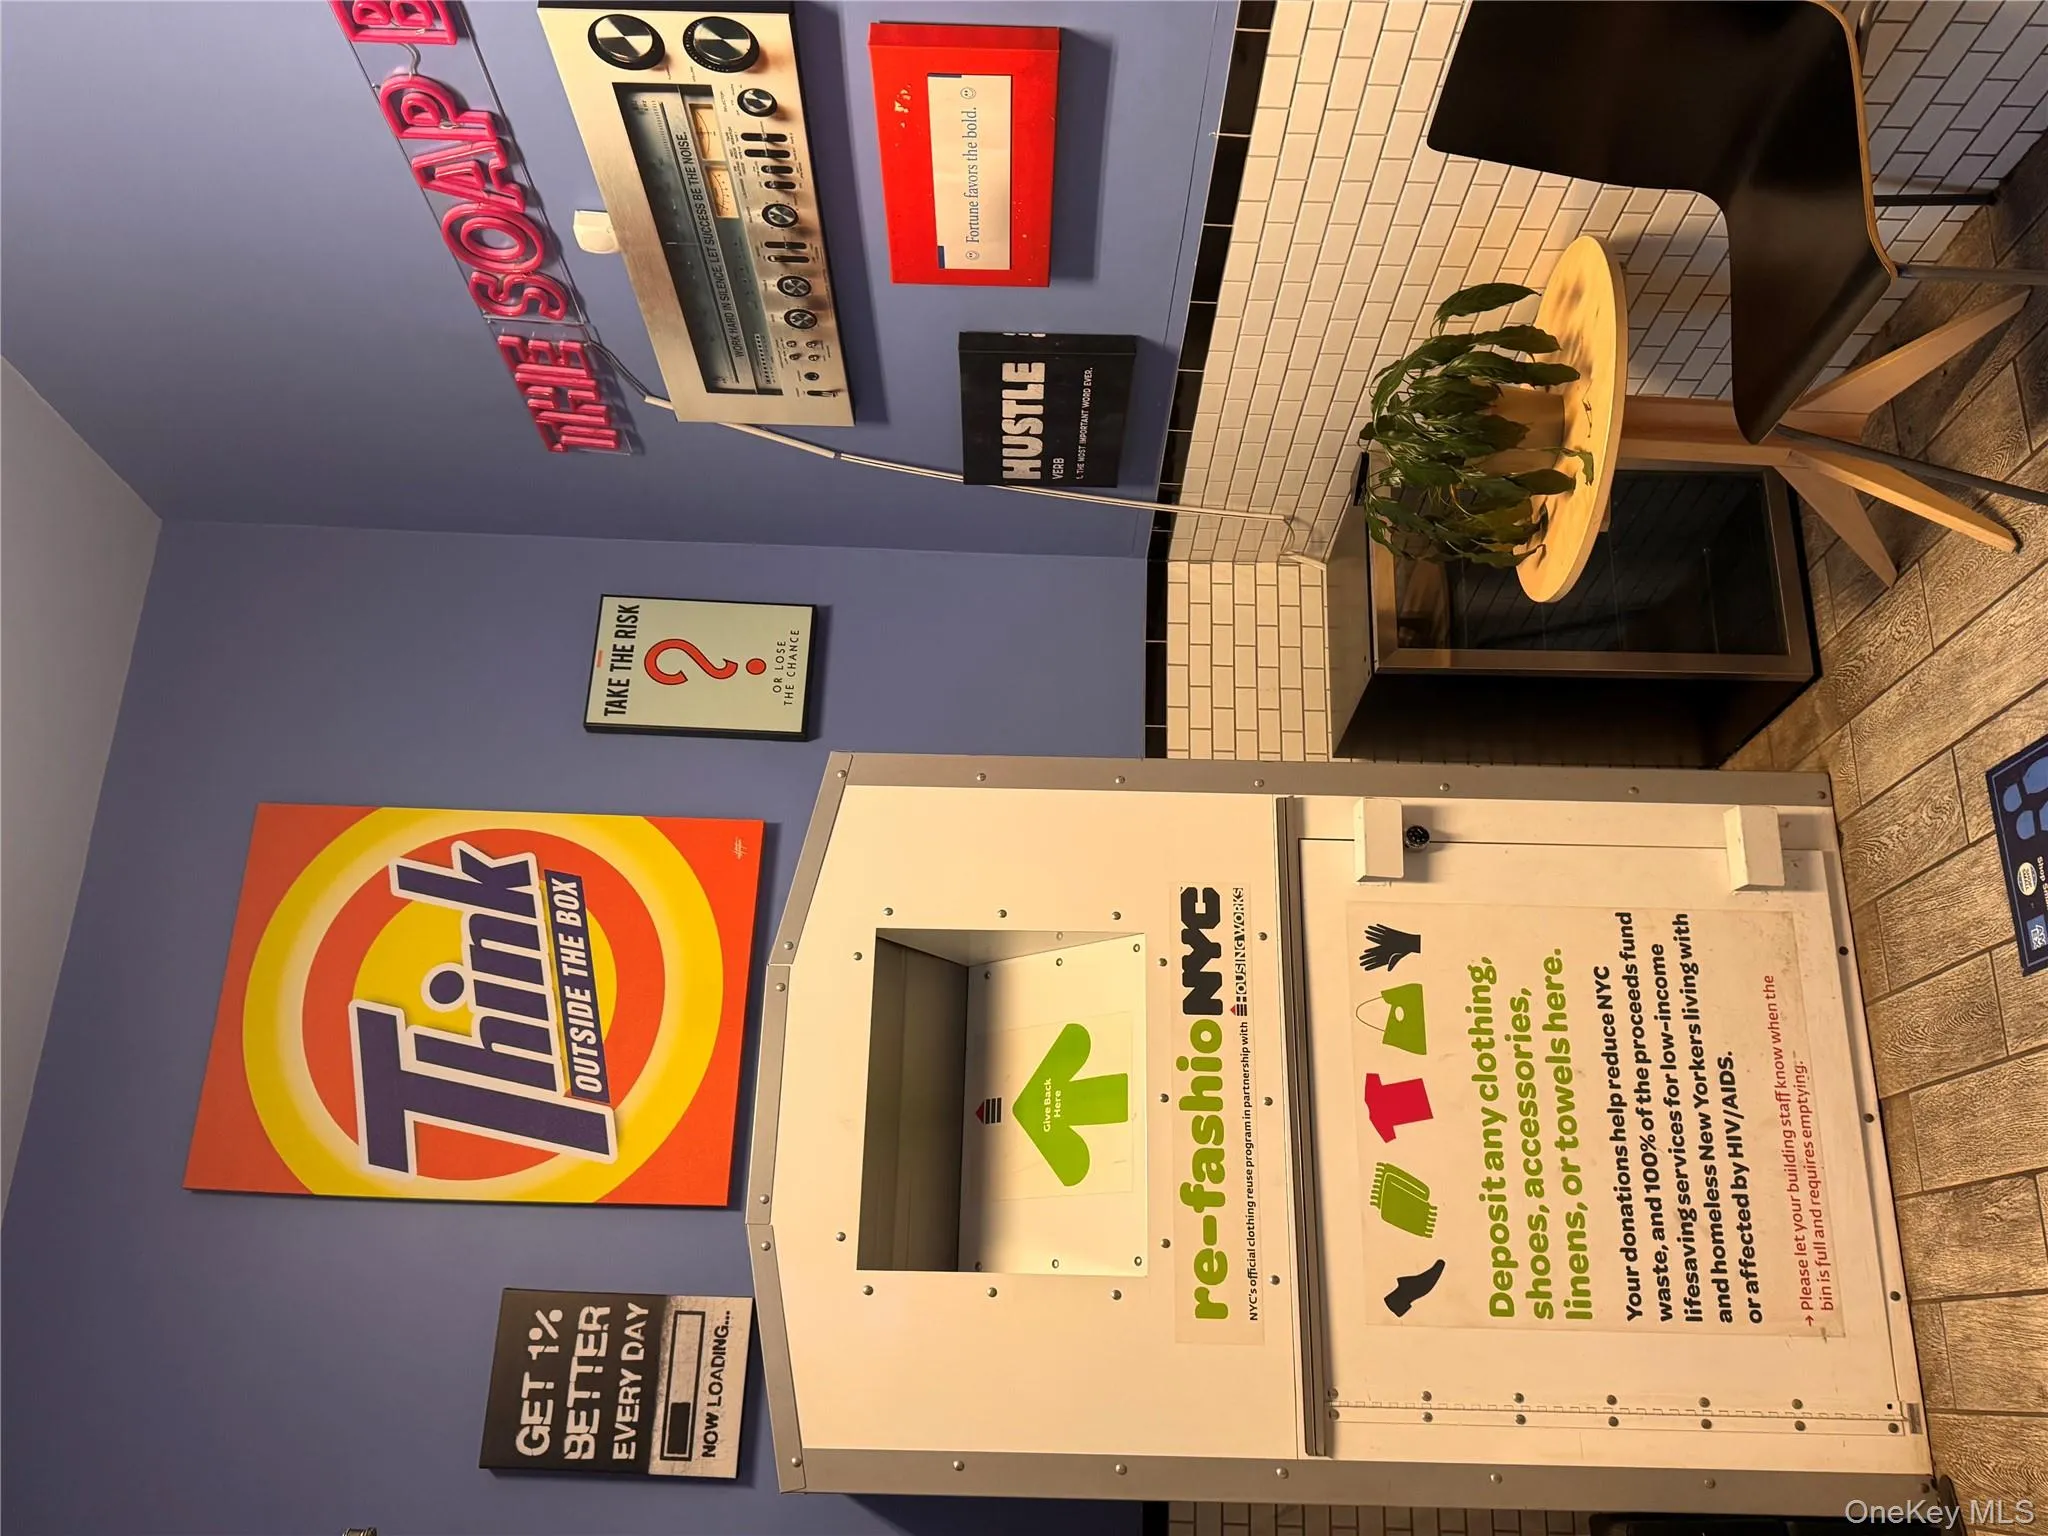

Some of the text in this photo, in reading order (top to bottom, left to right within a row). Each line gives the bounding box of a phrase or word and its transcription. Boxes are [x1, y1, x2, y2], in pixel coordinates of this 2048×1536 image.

[676, 131, 695, 165] NOISE.
[684, 167, 699, 186] THE
[961, 107, 979, 243] Fortune favors the bold.
[378, 73, 568, 322] SOAP
[689, 187, 703, 201] BE
[693, 202, 715, 245] SUCCESS
[706, 247, 720, 263] LET
[722, 302, 733, 311] IN
[725, 312, 740, 334] HARD
[730, 335, 745, 358] WORK
[497, 335, 620, 453] THE
[1082, 388, 1091, 408] WORD
[1084, 367, 1093, 386] EVER.
[1002, 362, 1045, 479] HUSTLE
[1079, 410, 1089, 444] IMPORTANT
[1052, 457, 1065, 479] VERB
[1076, 463, 1085, 473] THE
[1077, 445, 1087, 462] MOST
[603, 604, 640, 716] TAKE THE RISK
[772, 641, 786, 693] OR LOSE
[783, 629, 799, 706] THE CHANCE
[2037, 856, 2045, 881] Shop
[1233, 888, 1247, 1003] HOUSING WORKS
[353, 844, 613, 1176] Think
[550, 876, 602, 1093] OUTSIDE THE BOX
[1239, 1022, 1248, 1045] with
[1043, 1078, 1052, 1132] Give Back
[1054, 1090, 1062, 1118] Here
[1240, 1047, 1252, 1108] partnership
[1242, 1110, 1251, 1119] in
[1465, 956, 1519, 1317] Deposit any clothing,
[1542, 948, 1593, 1320] linens, or towels here.
[1615, 911, 1673, 1321] waste, and 100% of the proceeds fund
[1651, 944, 1703, 1322] lifesaving services for low-income
[1672, 913, 1733, 1323] and homeless New Yorkers living with
[1763, 975, 1814, 1311] Please let your building staff know when the
[1244, 1121, 1254, 1167] program
[1504, 988, 1554, 1320] shoes, accessories,
[1593, 966, 1643, 1321] Your donations help reduce NYC
[1717, 1051, 1763, 1324] or affected by HIV/AIDS.
[1793, 1061, 1834, 1311] bin is full and requires emptying.
[1245, 1201, 1256, 1247] clothing
[1247, 1249, 1258, 1286] official
[1248, 1288, 1258, 1321] NYC's
[515, 1309, 563, 1457] GET 1%
[564, 1306, 611, 1460] BETTER
[612, 1302, 649, 1460] EVERY DAY
[702, 1310, 730, 1458] NOW LOADING...
